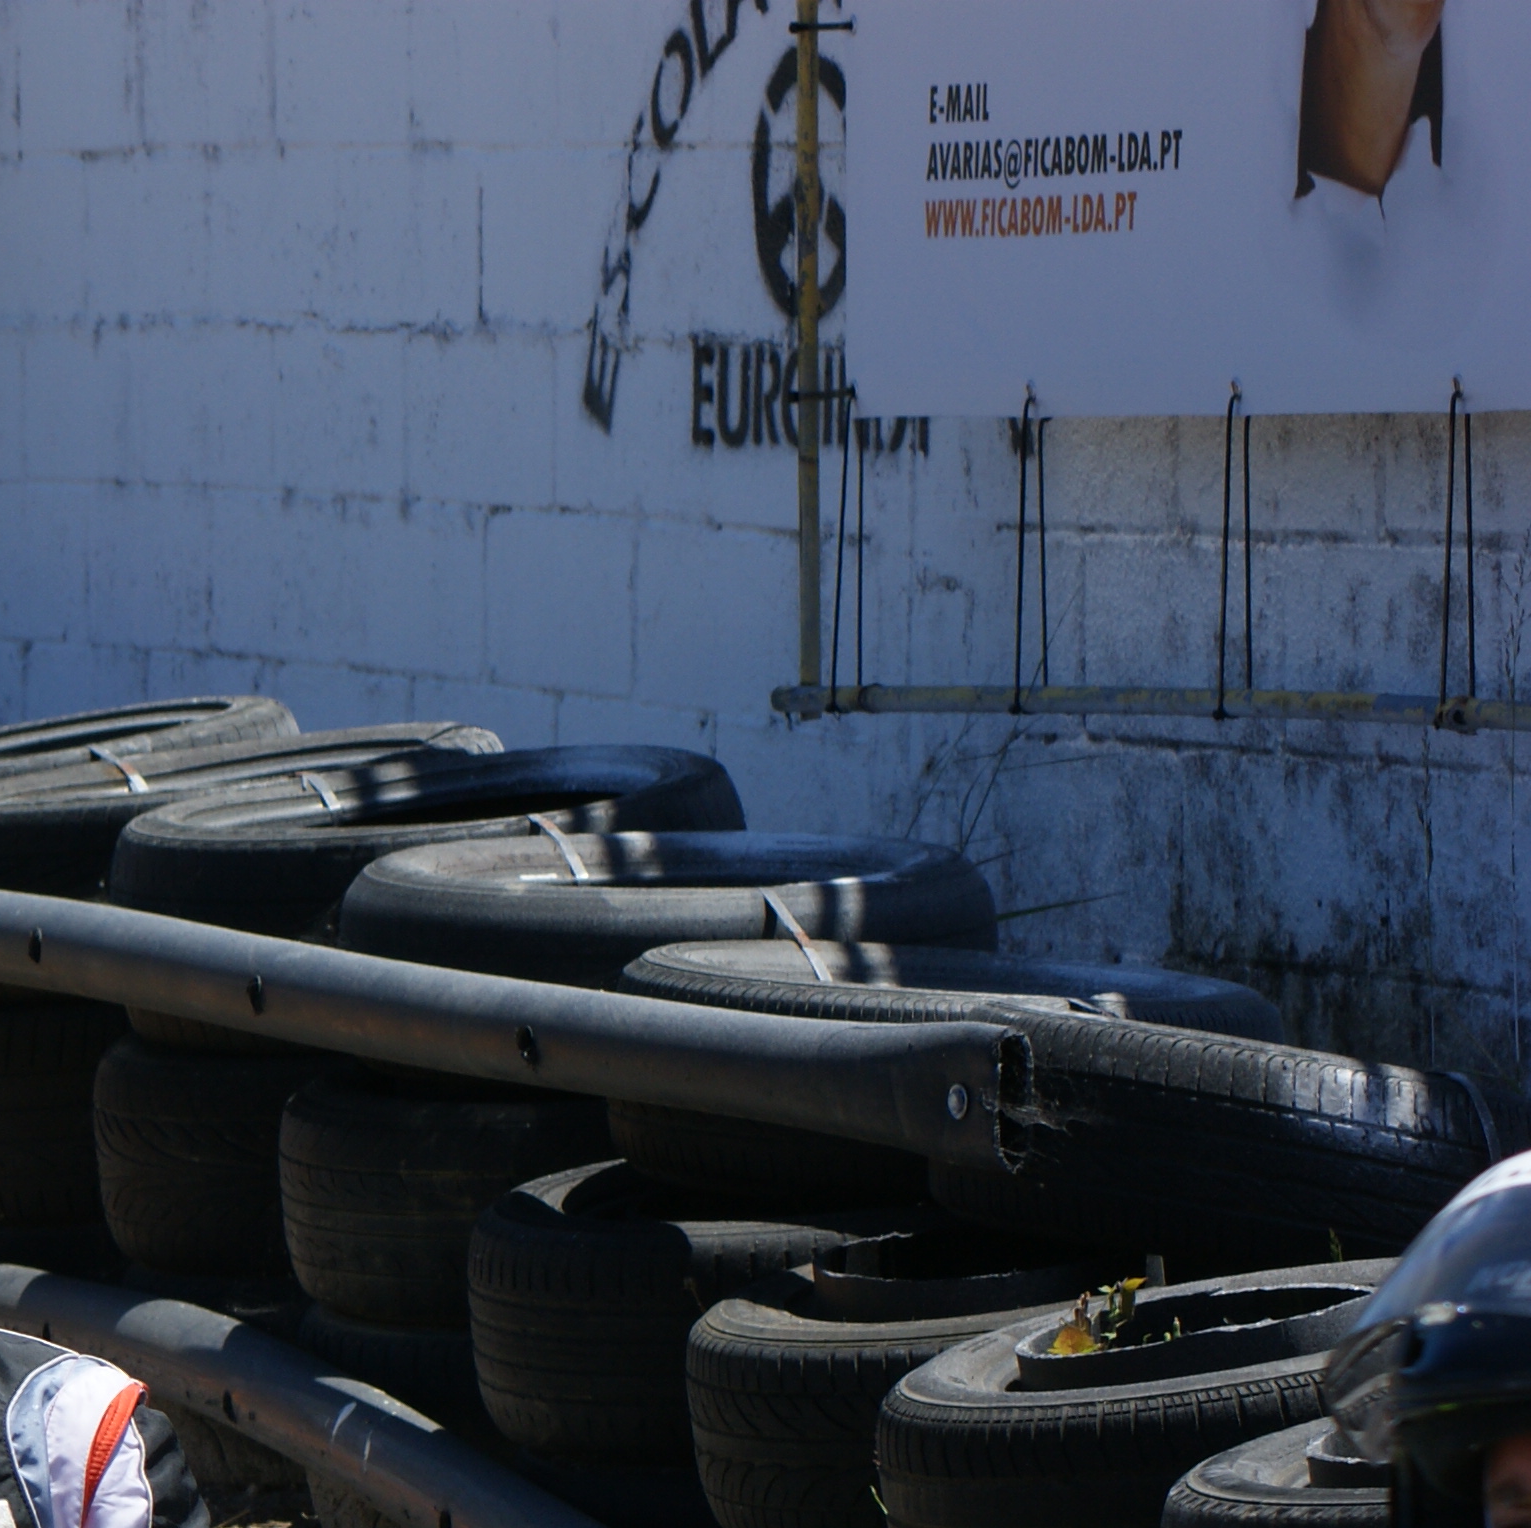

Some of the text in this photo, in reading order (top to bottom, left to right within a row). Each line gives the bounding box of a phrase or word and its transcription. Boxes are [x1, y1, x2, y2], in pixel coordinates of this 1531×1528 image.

[929, 83, 989, 124] E-MAIL
[926, 129, 1183, 190] AVARIAS@FICABOM-LDA.PT
[925, 191, 1137, 238] WWW.FICABOM-LDA.PT
